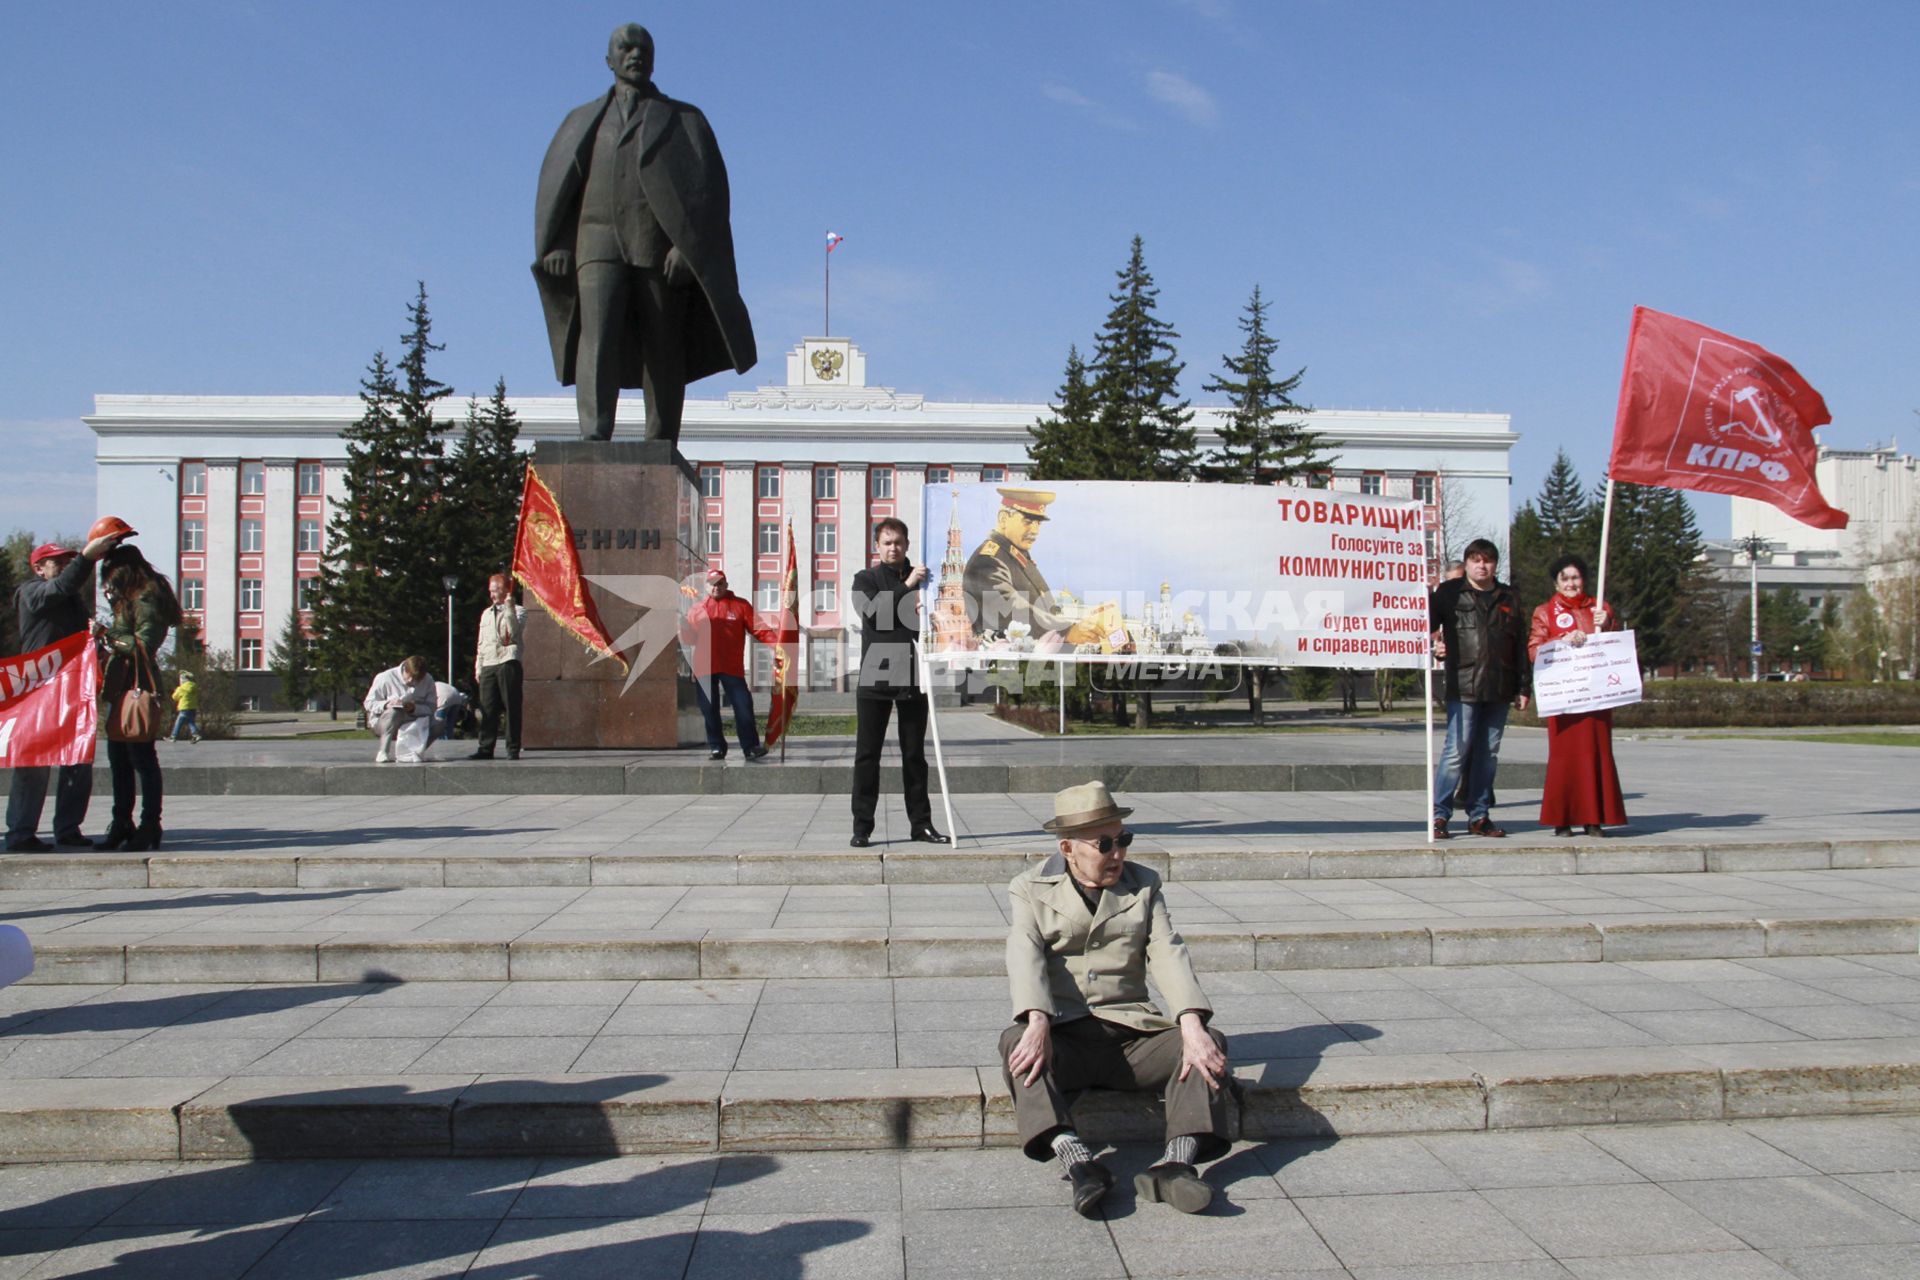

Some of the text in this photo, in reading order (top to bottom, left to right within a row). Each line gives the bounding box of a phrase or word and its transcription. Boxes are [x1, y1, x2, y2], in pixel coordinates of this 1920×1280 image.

[1686, 443, 1790, 481] КПРФ
[1278, 499, 1422, 533] ТОВАРИЩИ!
[573, 528, 661, 550] ЕНИН
[1331, 534, 1423, 556] Голосуйте за
[1279, 556, 1424, 583] КОММУНИСТОВ!
[1372, 591, 1427, 610] Россия
[1324, 612, 1428, 634] будет единой
[1298, 636, 1428, 656] и справедливой!
